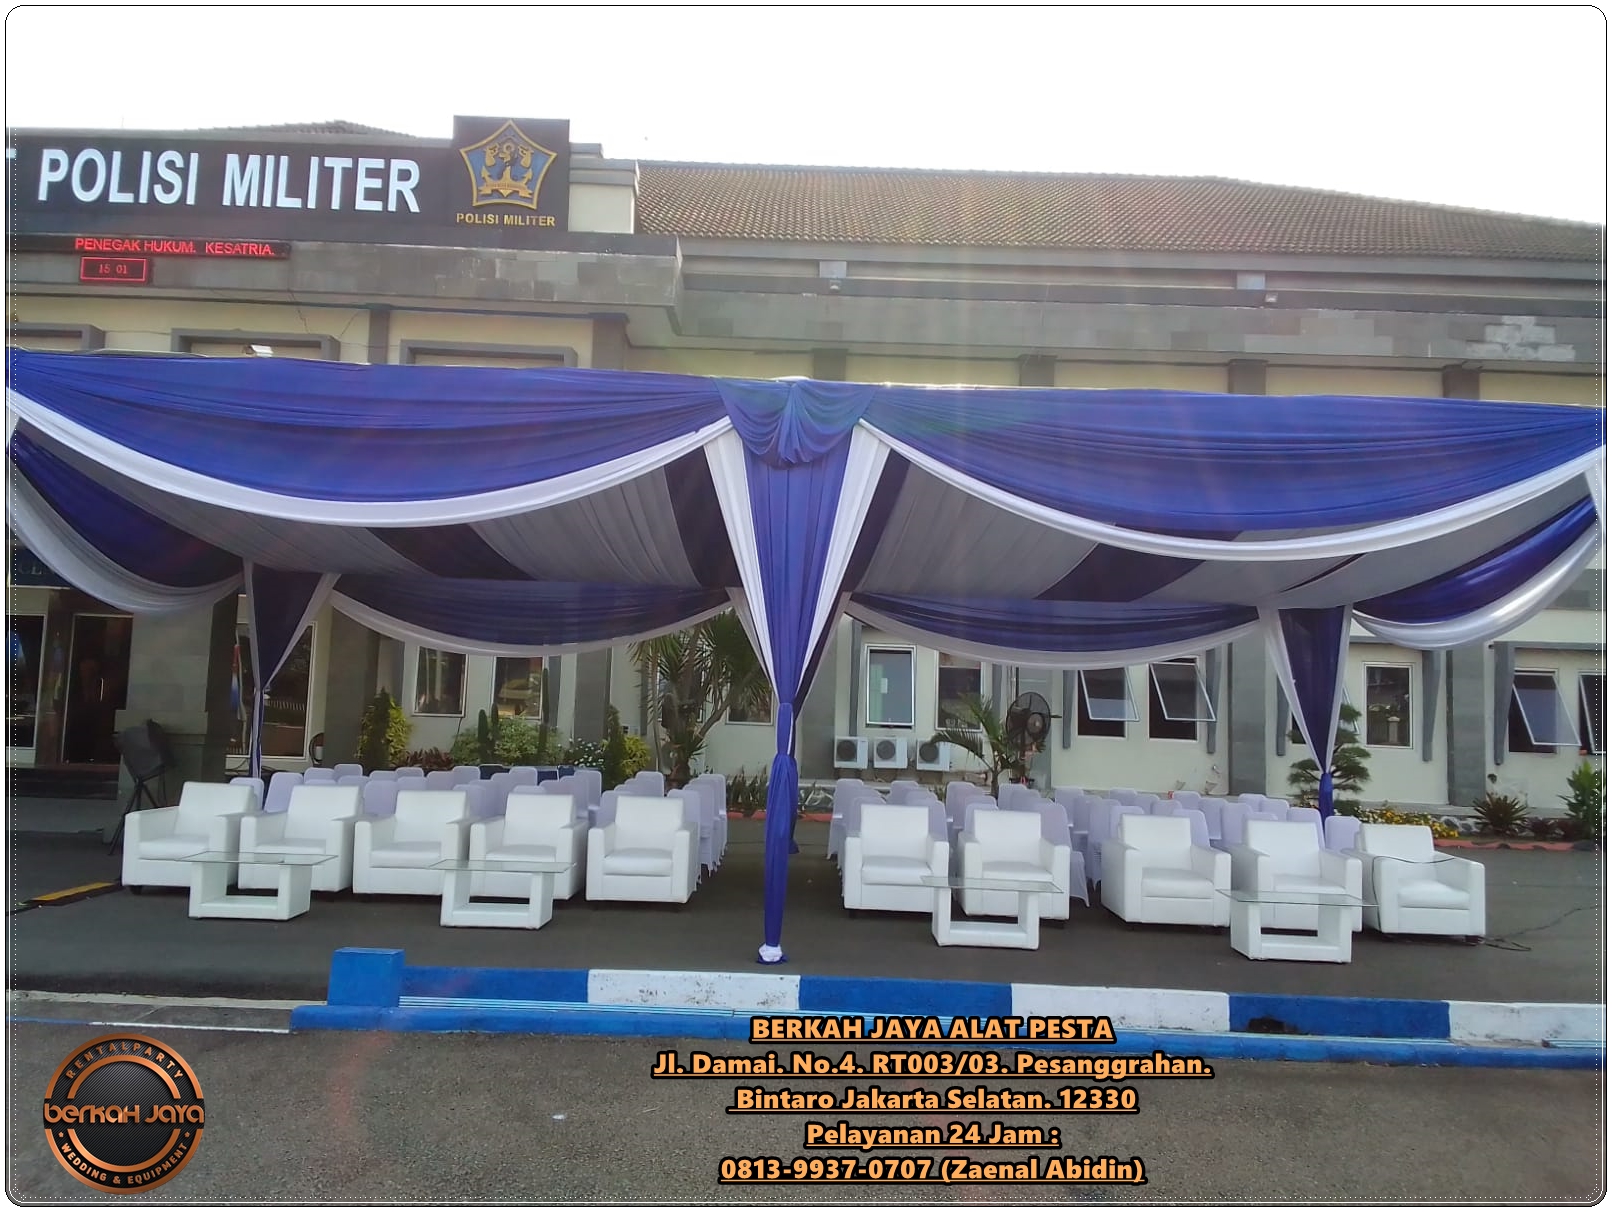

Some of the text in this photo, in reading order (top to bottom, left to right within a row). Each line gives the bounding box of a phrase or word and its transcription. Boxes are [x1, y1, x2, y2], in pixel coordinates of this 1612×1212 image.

[37, 147, 421, 213] POLISI MILITER
[456, 213, 556, 227] POLISI MILITER
[74, 236, 276, 256] PENEGAK HUKUM. KESATRIA.
